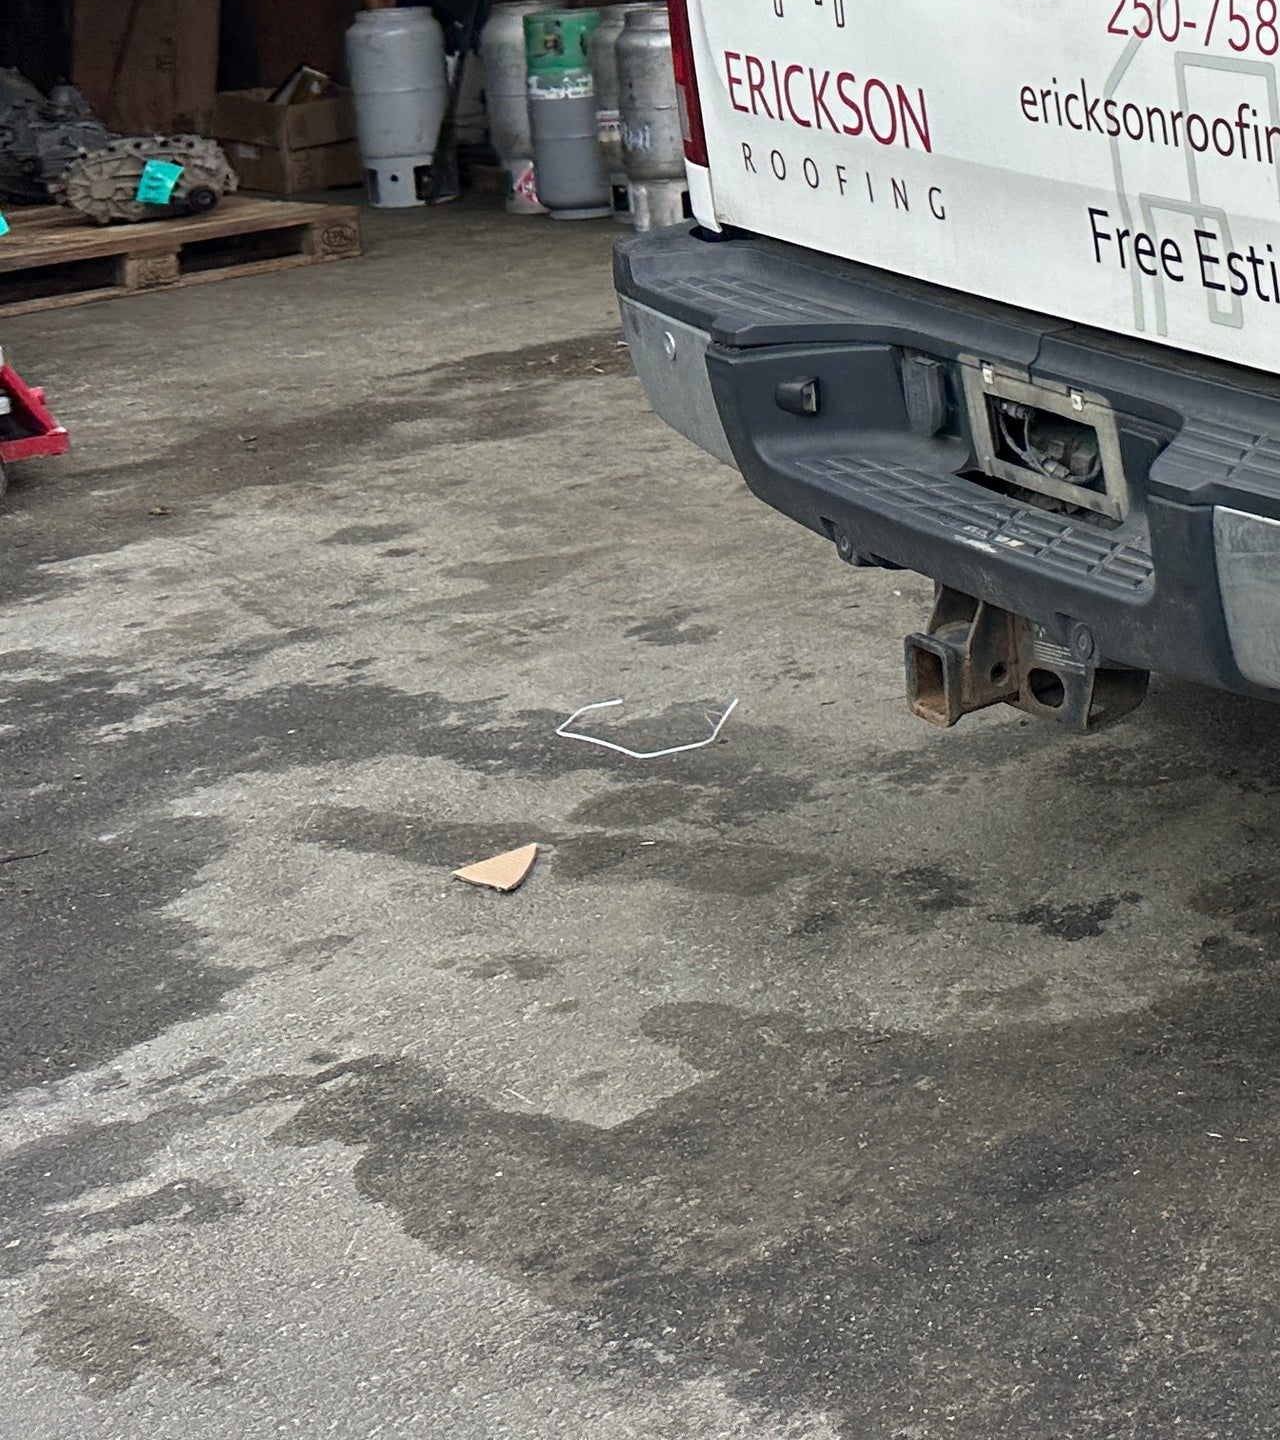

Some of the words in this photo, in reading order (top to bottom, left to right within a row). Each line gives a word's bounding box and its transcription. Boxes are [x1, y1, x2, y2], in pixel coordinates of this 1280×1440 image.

[724, 50, 932, 153] ERICKSON
[741, 142, 946, 221] ROOFING
[1087, 207, 1184, 282] Free
